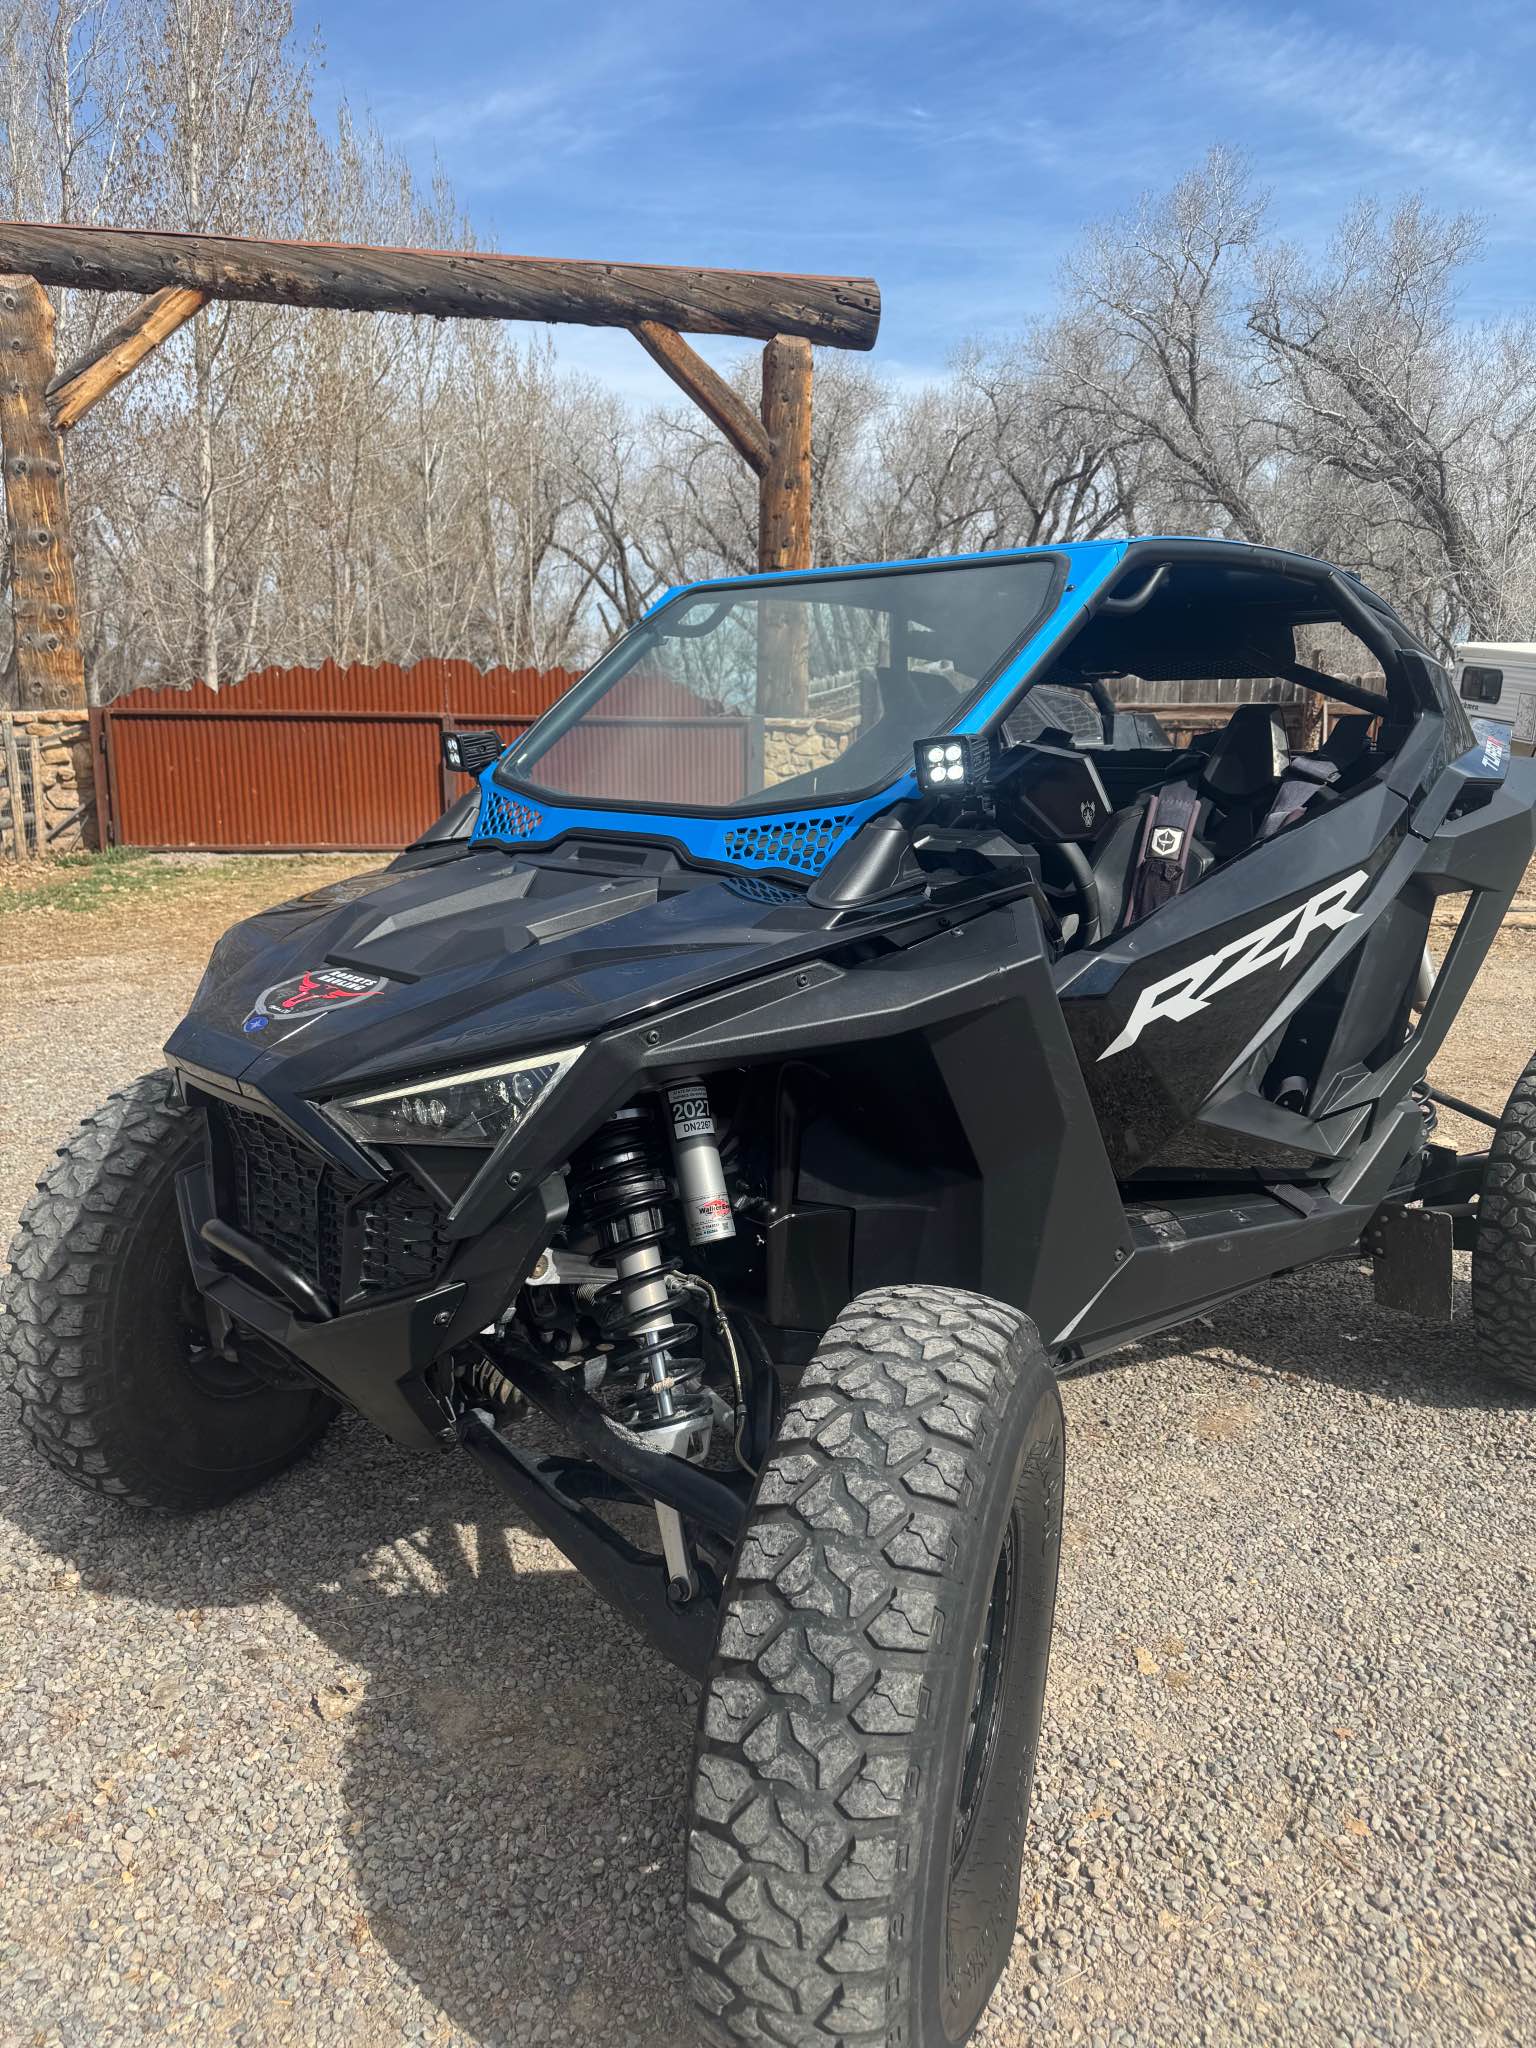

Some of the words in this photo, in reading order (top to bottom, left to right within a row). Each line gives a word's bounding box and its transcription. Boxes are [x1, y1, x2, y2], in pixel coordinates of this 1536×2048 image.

[1096, 870, 1369, 1062] RZR
[317, 975, 366, 990] HAULING
[672, 1100, 709, 1121] 2027
